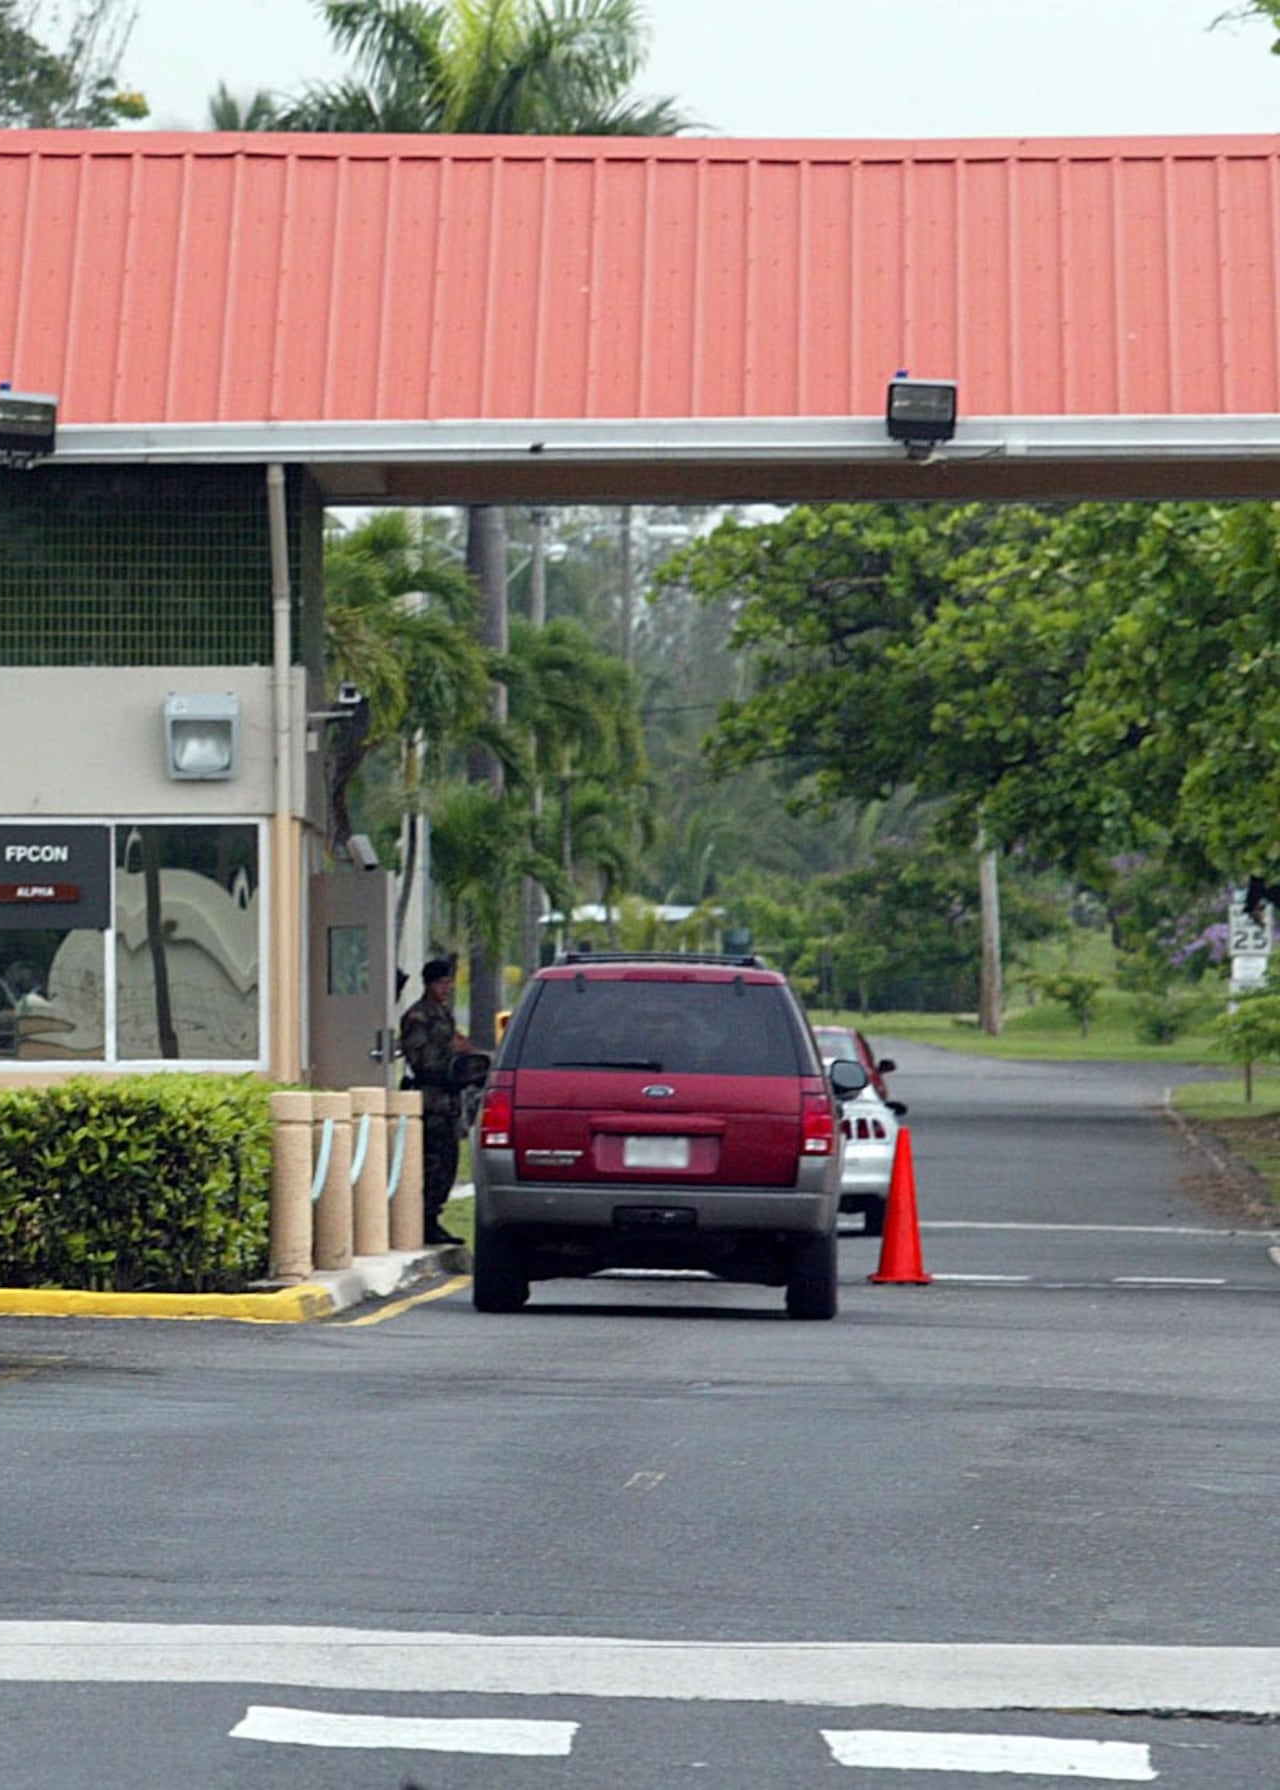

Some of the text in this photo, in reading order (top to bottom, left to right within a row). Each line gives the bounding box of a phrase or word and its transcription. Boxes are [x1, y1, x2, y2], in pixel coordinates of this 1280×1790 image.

[5, 845, 69, 862] FPCON
[16, 886, 55, 897] ALPHA
[1234, 931, 1267, 949] 25
